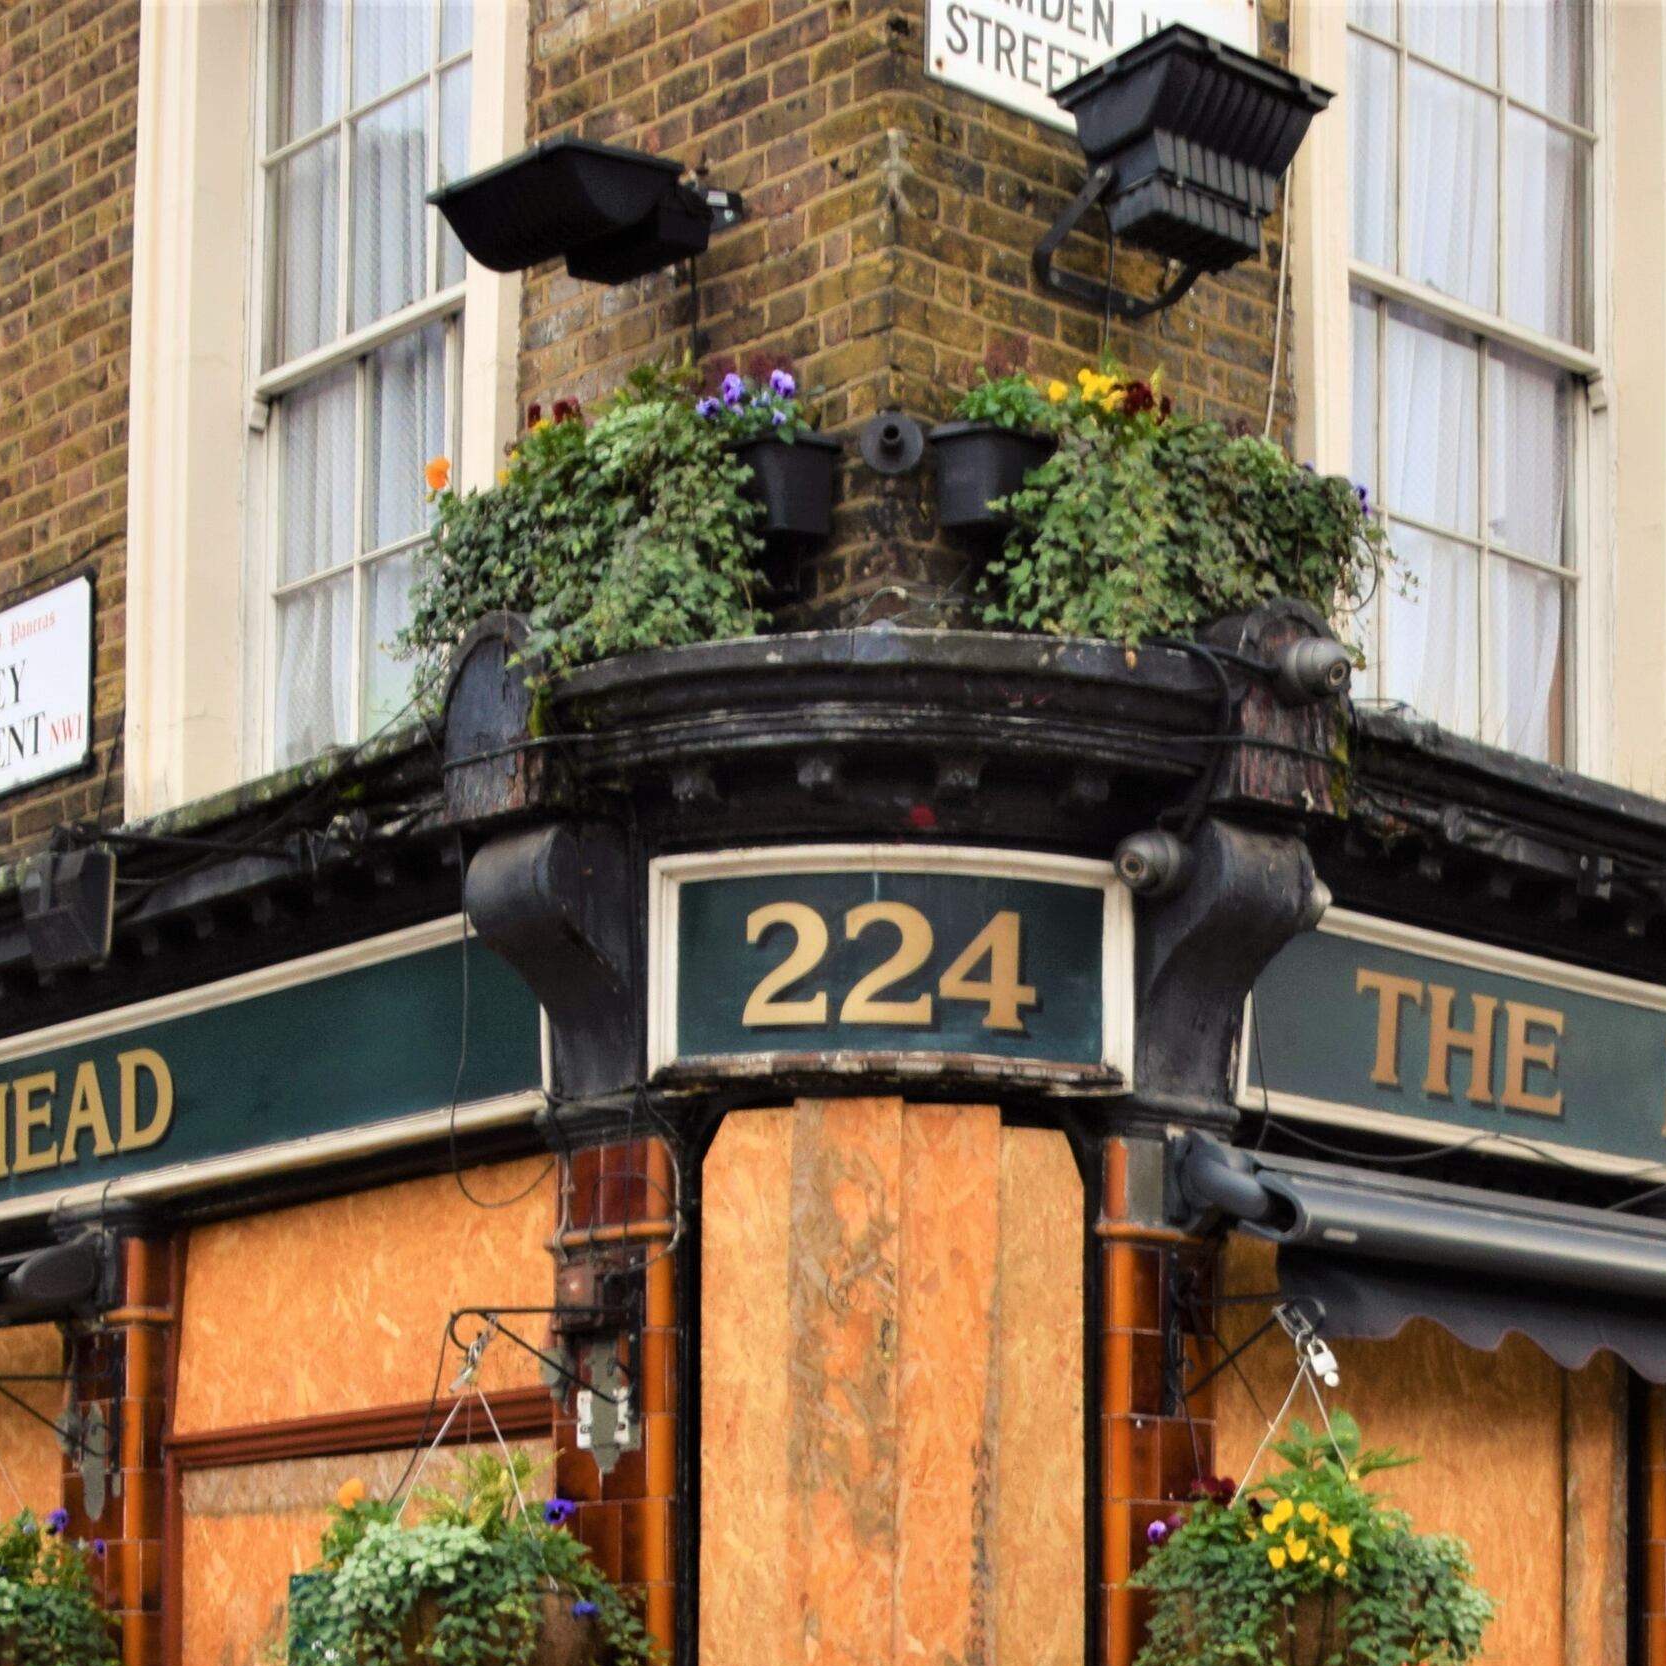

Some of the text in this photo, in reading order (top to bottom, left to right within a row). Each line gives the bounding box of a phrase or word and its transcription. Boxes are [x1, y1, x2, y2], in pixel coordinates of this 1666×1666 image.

[10, 611, 56, 648] Pancras
[49, 711, 84, 751] NW1
[742, 901, 1037, 1031] 224
[1354, 967, 1566, 1118] THE
